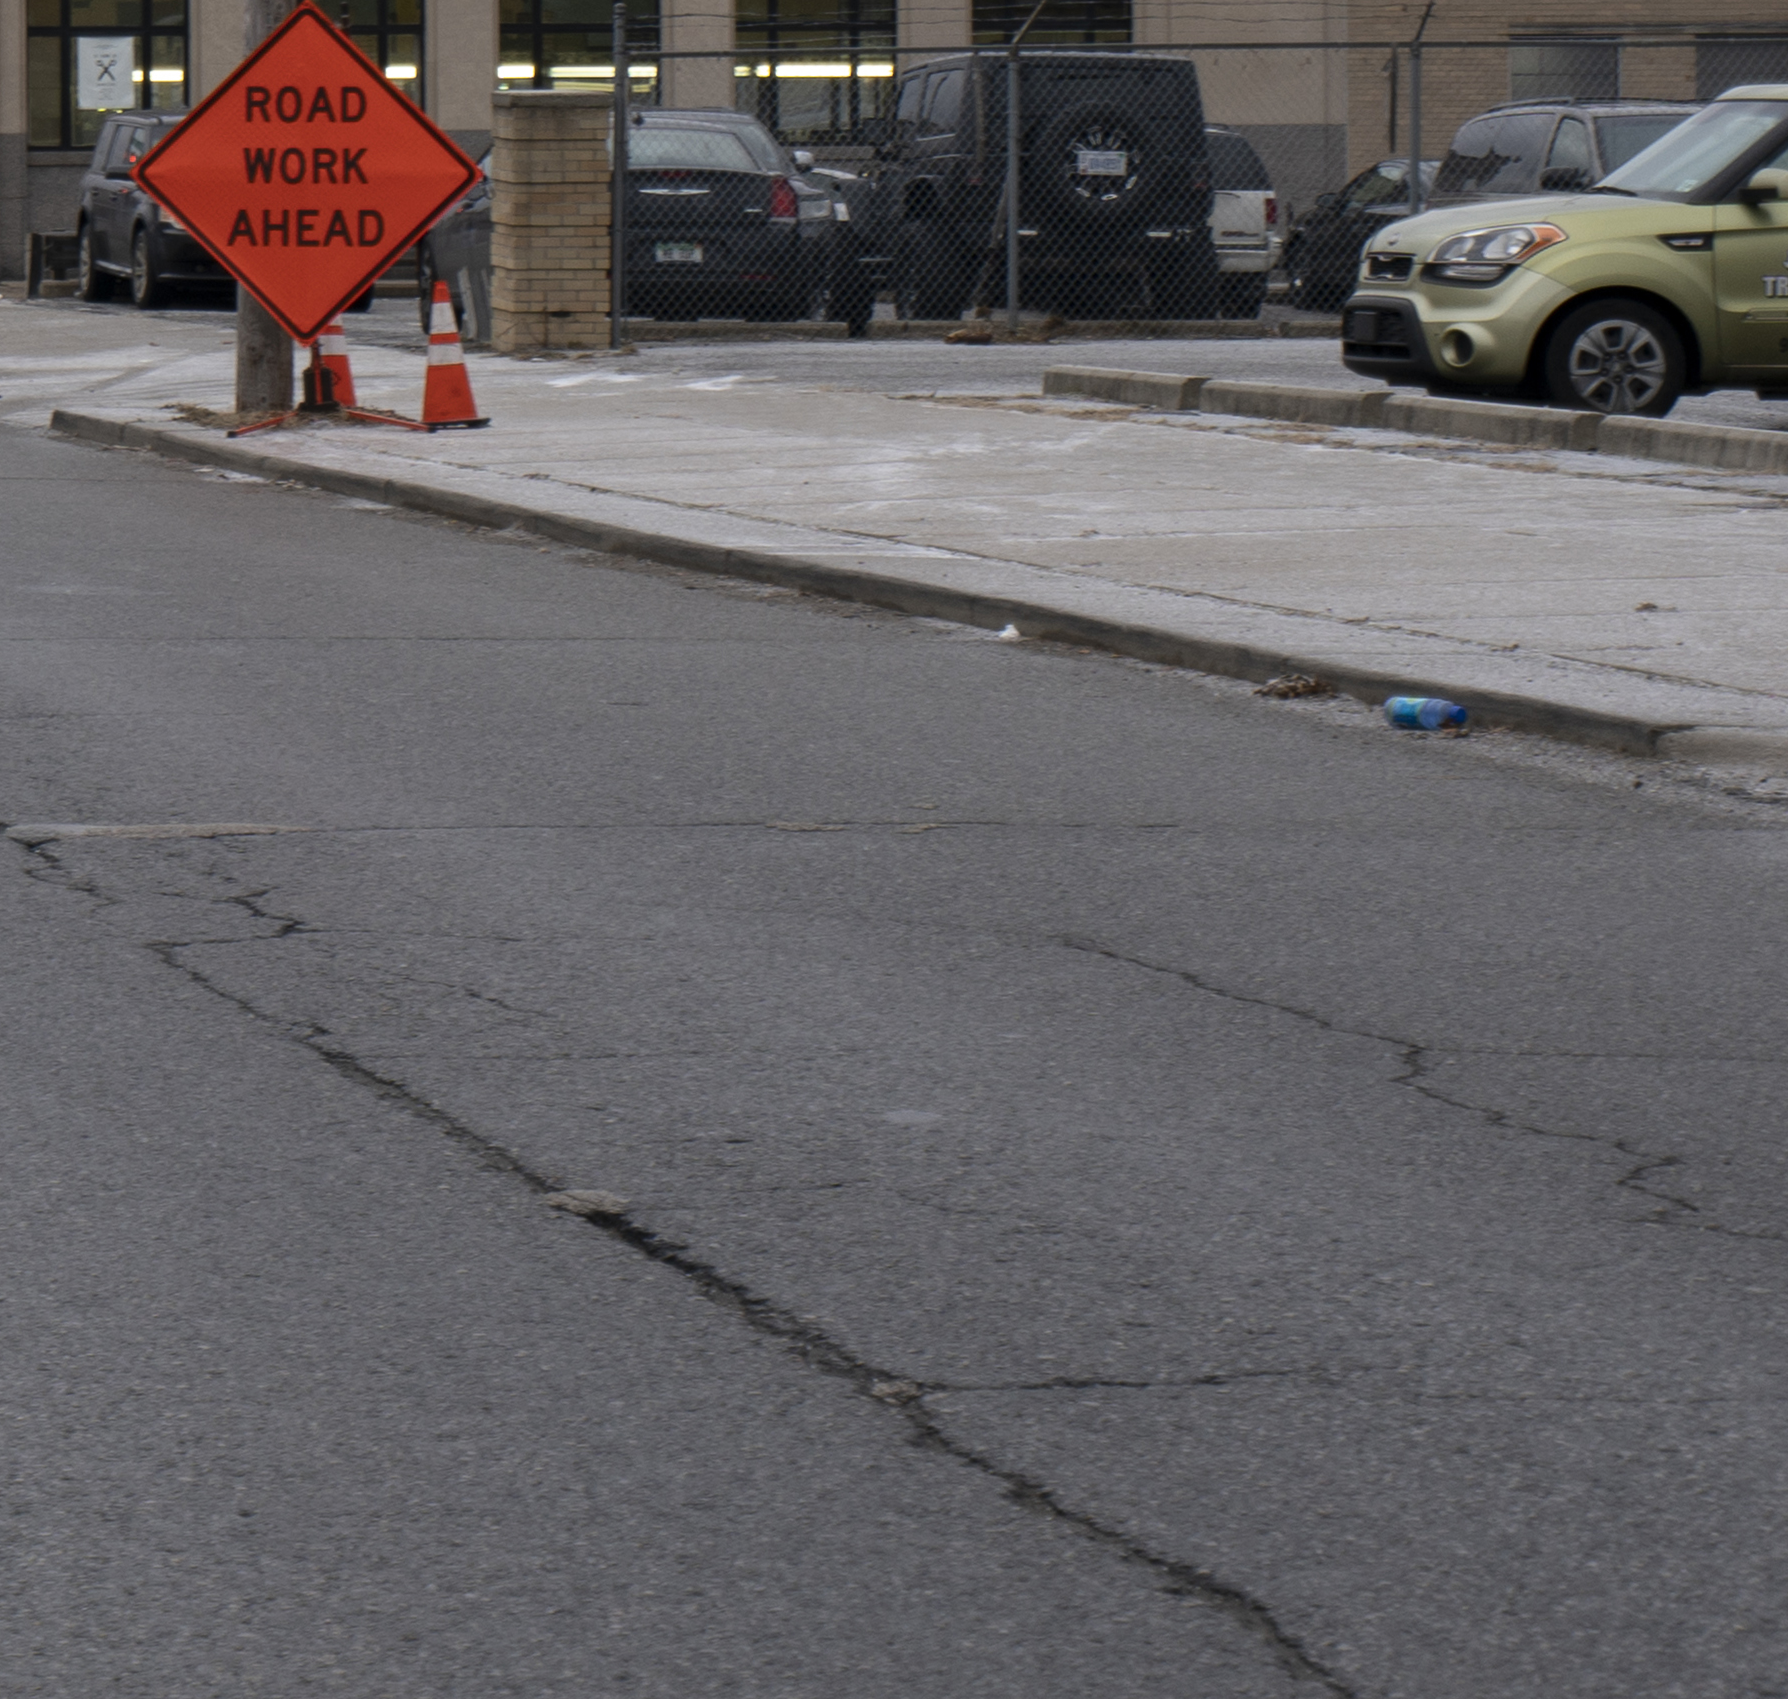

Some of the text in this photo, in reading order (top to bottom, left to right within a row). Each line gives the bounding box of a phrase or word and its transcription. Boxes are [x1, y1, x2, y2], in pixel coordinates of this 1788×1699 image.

[246, 86, 367, 123] ROAD
[243, 148, 368, 185] WORK
[227, 209, 384, 247] AHEAD
